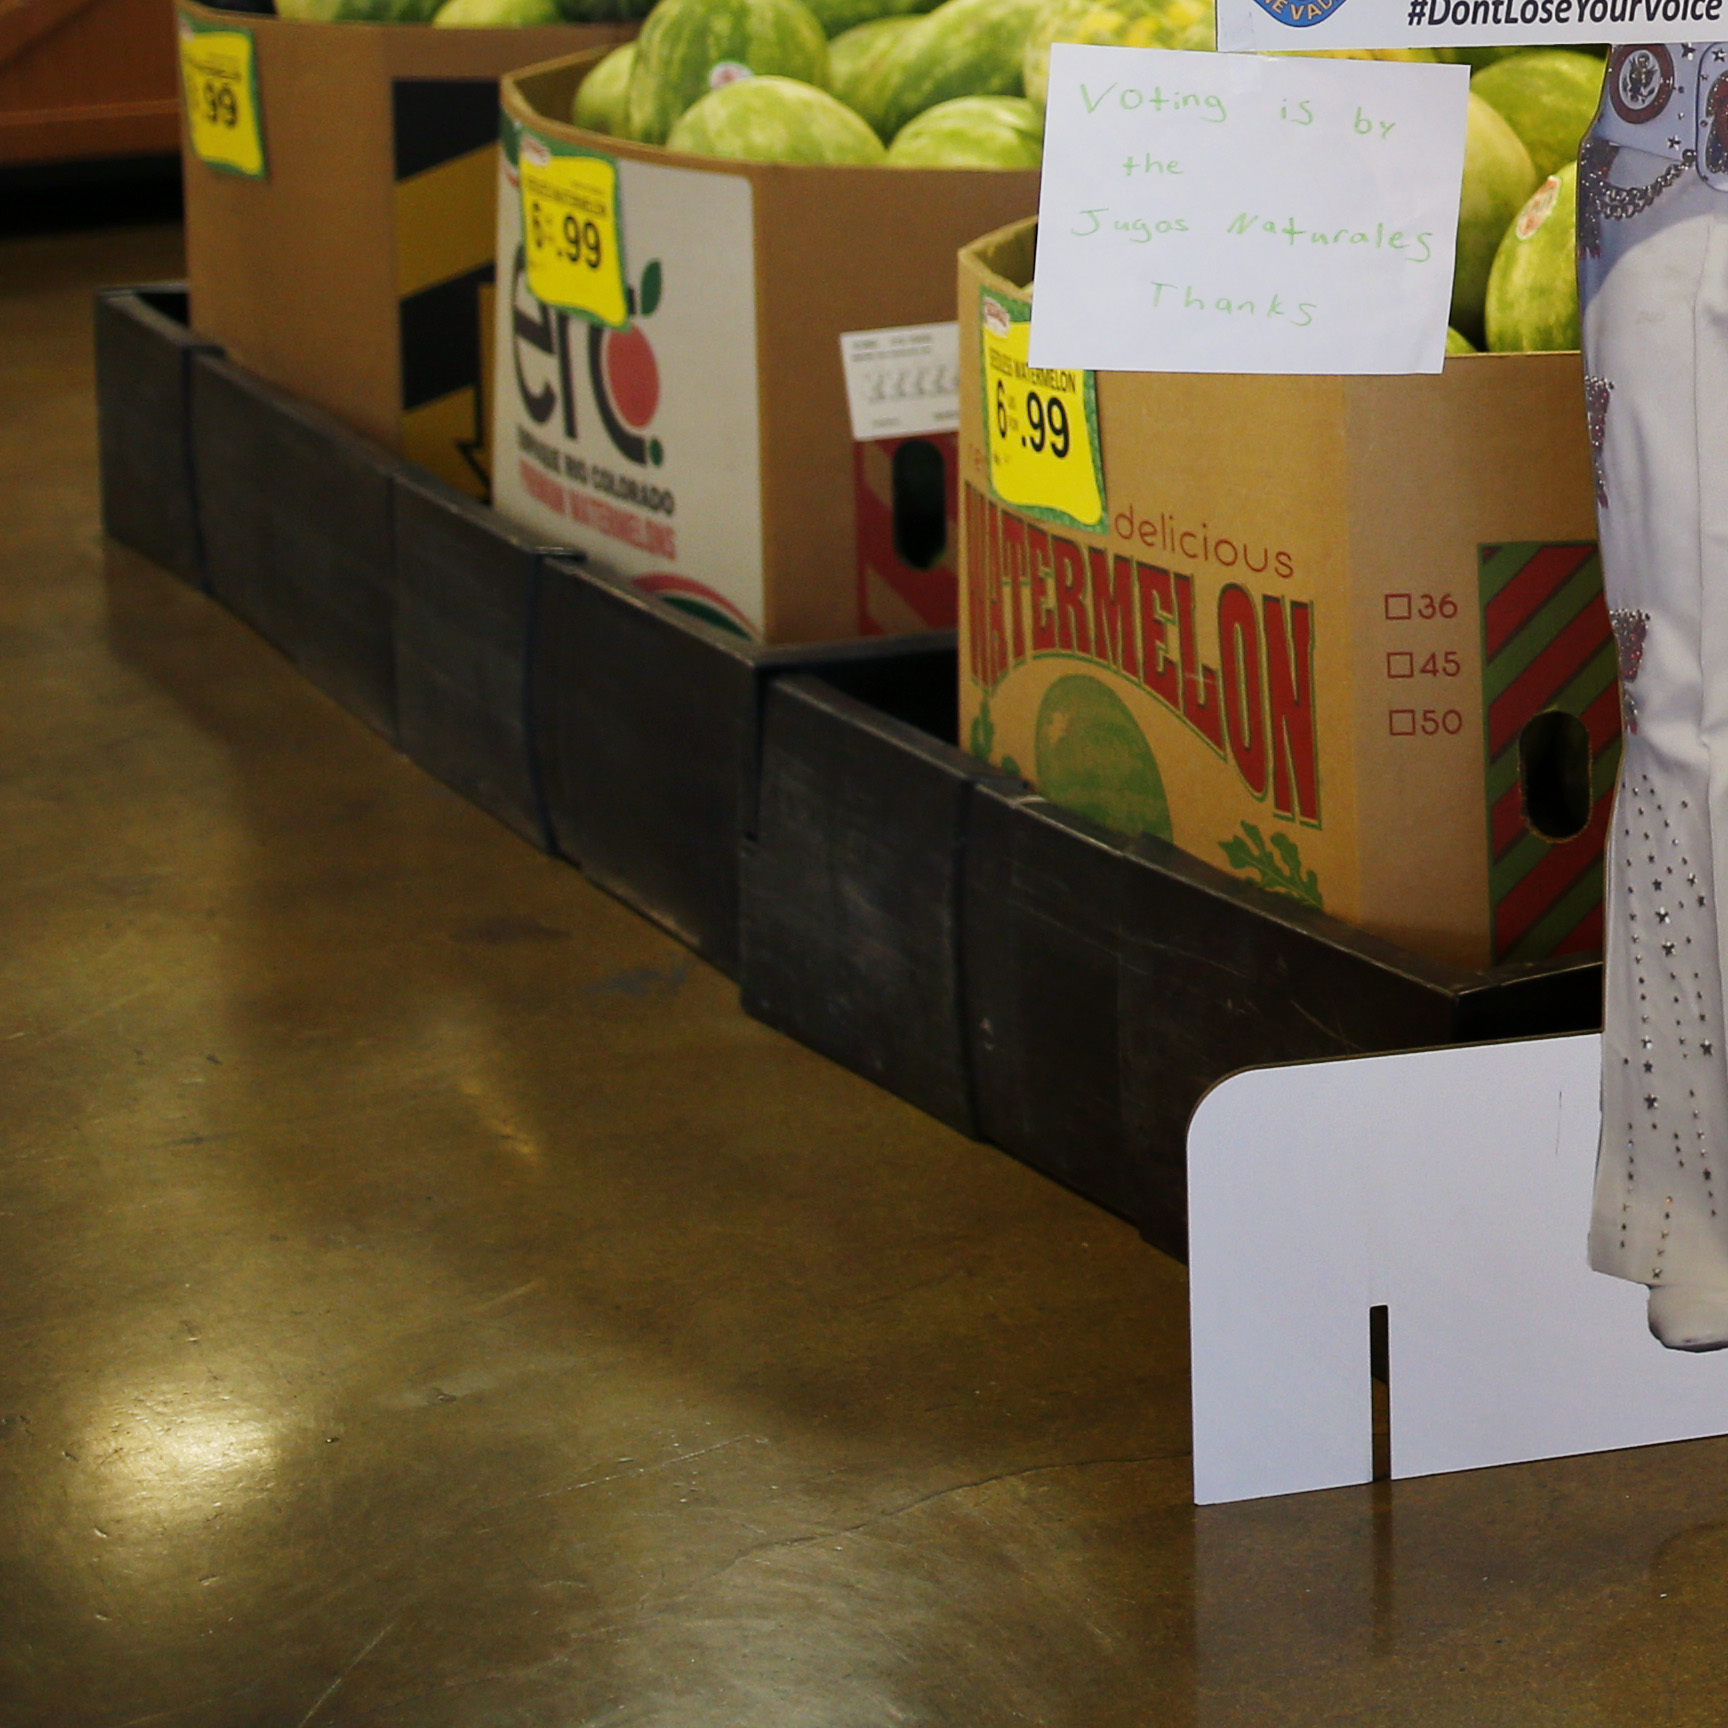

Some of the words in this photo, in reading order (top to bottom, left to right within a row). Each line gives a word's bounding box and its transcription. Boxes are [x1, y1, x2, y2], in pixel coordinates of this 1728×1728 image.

[1080, 82, 1228, 123] Voting
[1280, 98, 1314, 126] is
[1354, 106, 1396, 139] by
[1122, 152, 1185, 176] the
[1227, 212, 1432, 263] Naturales
[1151, 281, 1318, 327] Thanks
[996, 379, 1008, 439] 6
[1114, 503, 1296, 579] delicious
[1418, 594, 1458, 619] 36
[1419, 651, 1461, 677] 45
[1421, 709, 1463, 735] 50
